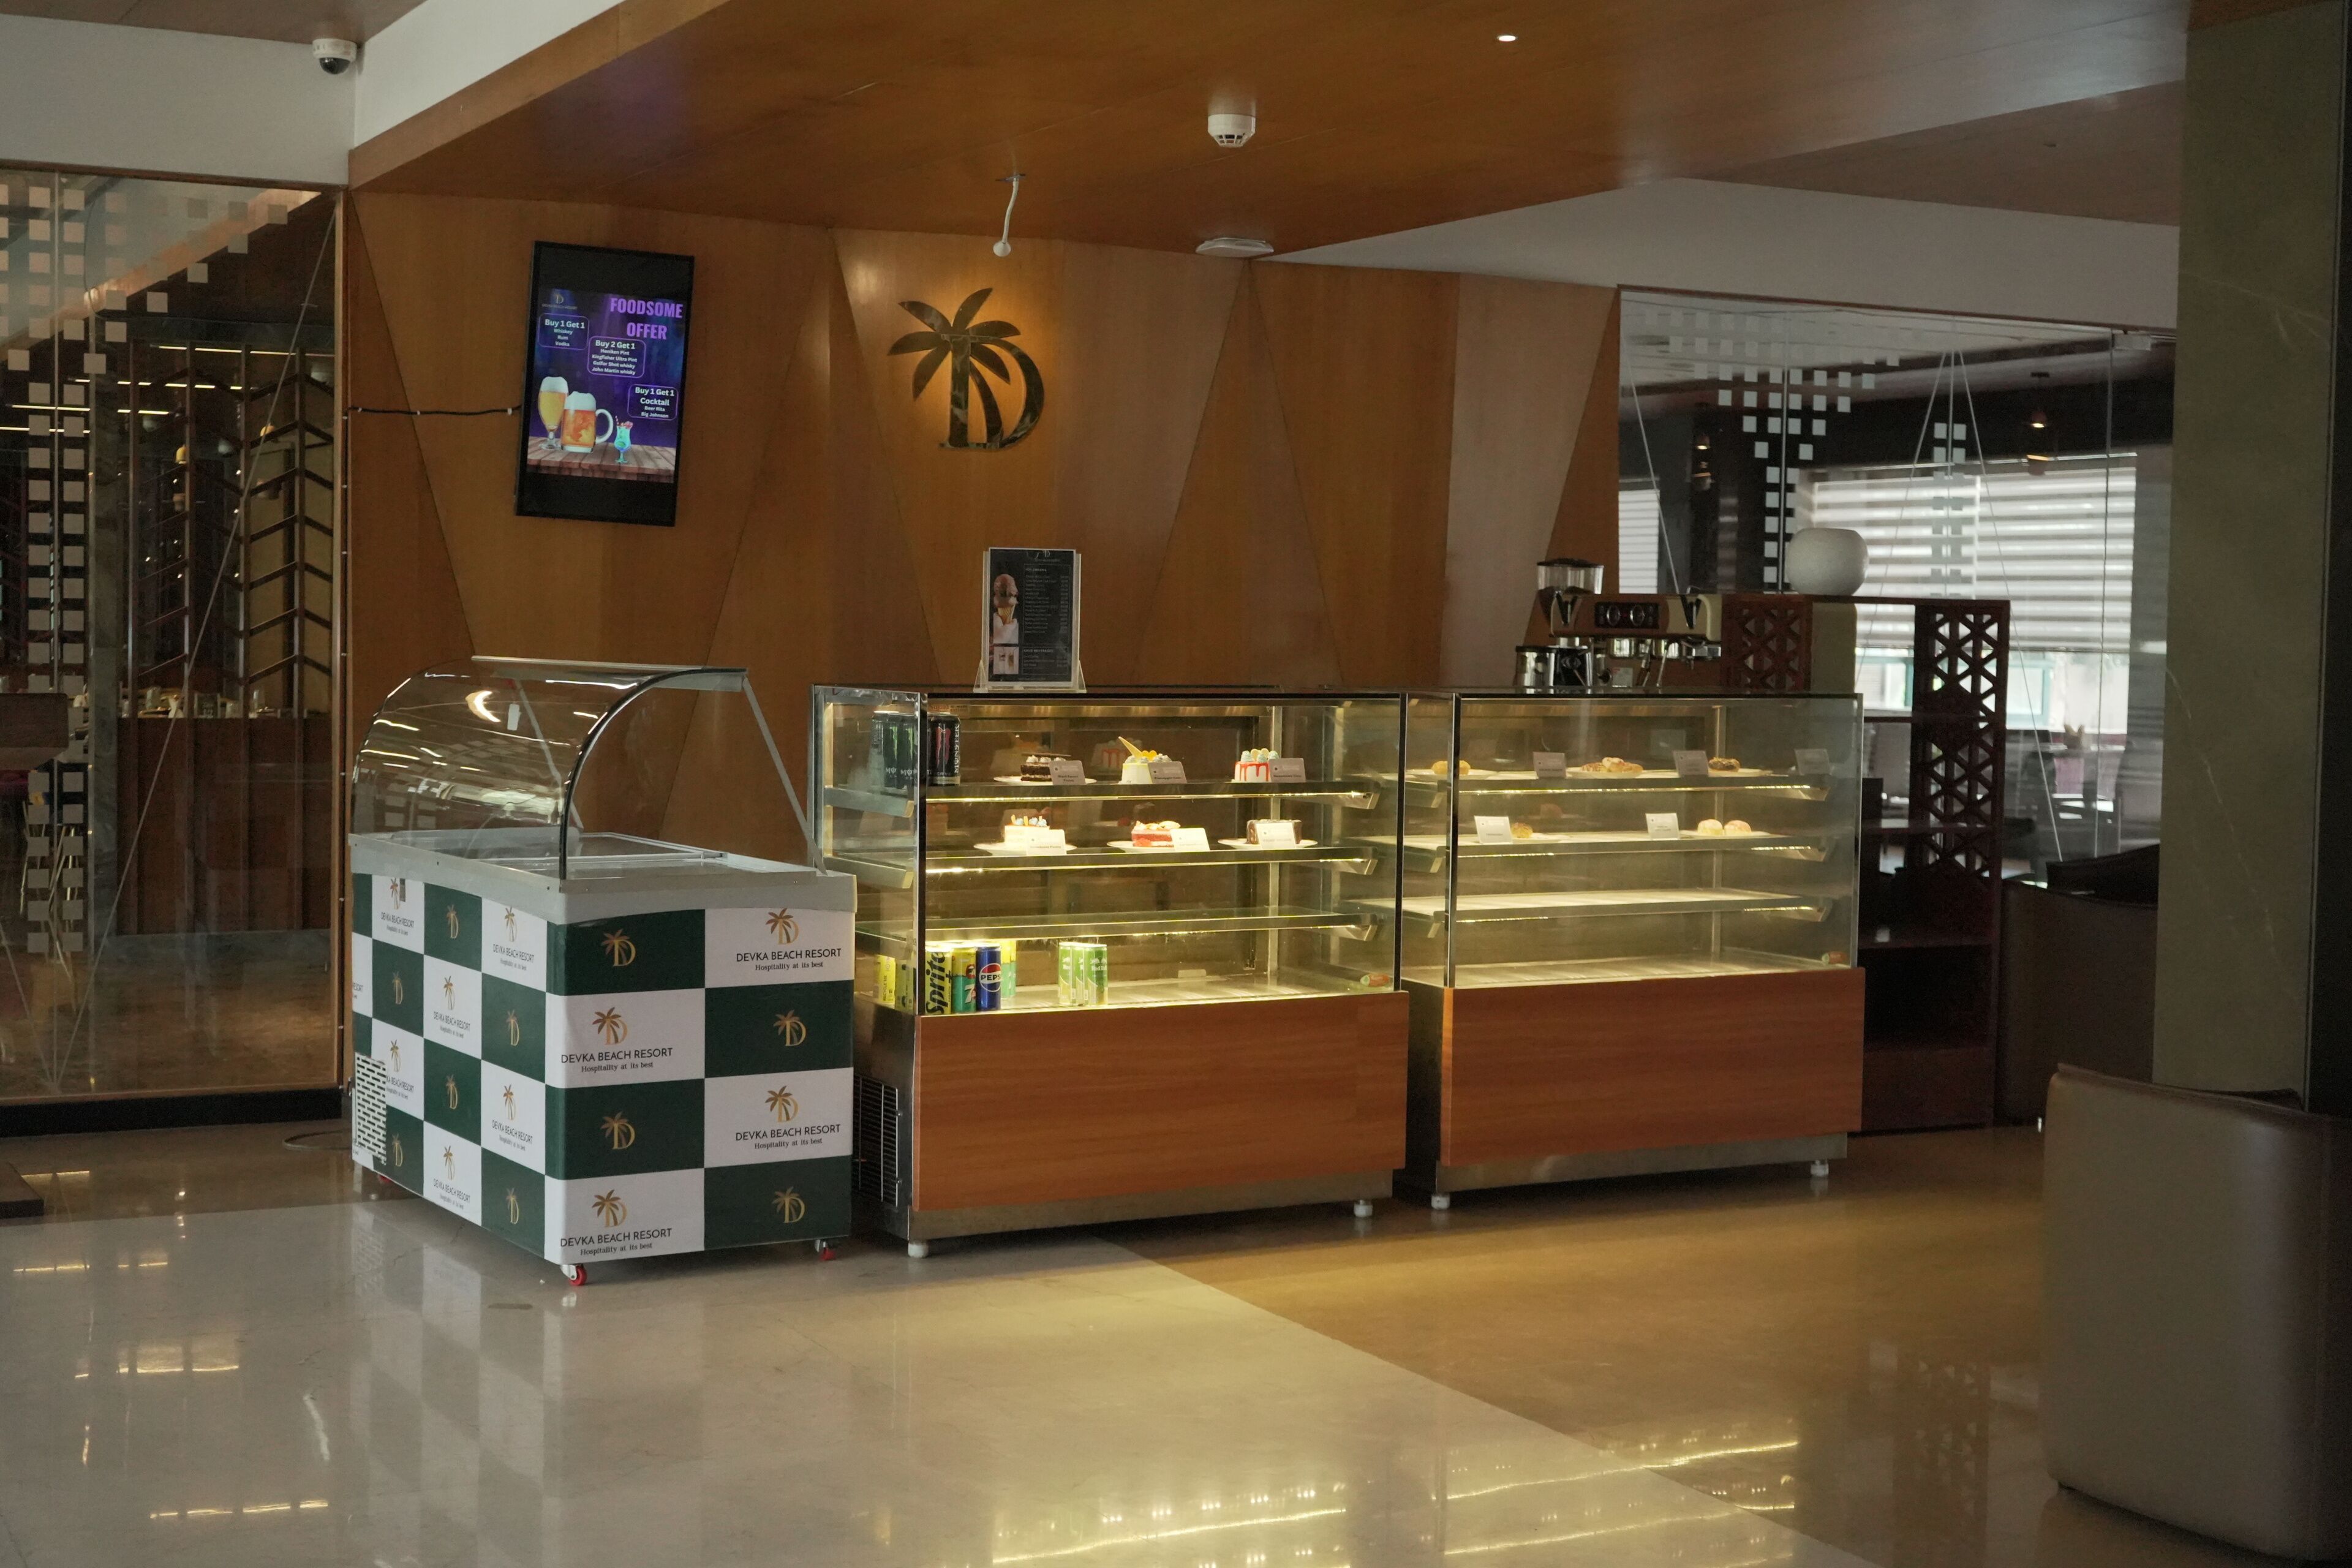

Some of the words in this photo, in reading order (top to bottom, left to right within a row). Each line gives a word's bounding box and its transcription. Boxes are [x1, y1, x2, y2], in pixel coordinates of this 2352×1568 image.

[610, 298, 684, 318] FOODSOME
[545, 318, 559, 328] Buy
[627, 322, 667, 340] OFFER
[635, 387, 649, 396] Buy
[519, 951, 534, 963] RESORT
[736, 952, 769, 962] DEVKA
[771, 950, 802, 960] BEACH
[805, 948, 842, 958] RESORT
[755, 963, 790, 971] Hospitality
[926, 952, 948, 1014] Sprite
[561, 1054, 595, 1063] DEVKA
[598, 1050, 631, 1061] BEACH
[634, 1048, 673, 1058] RESORT
[581, 1065, 617, 1073] Hospitality
[518, 1131, 533, 1144] RESORT
[736, 1131, 767, 1140] DEVKA
[771, 1127, 801, 1138] BEACH
[804, 1124, 841, 1135] RESORT
[755, 1141, 789, 1150] Hospitality
[560, 1236, 595, 1247] DEVKA
[598, 1232, 630, 1243] BEACH
[633, 1228, 672, 1240] RESORT
[580, 1247, 617, 1256] Hospitality
